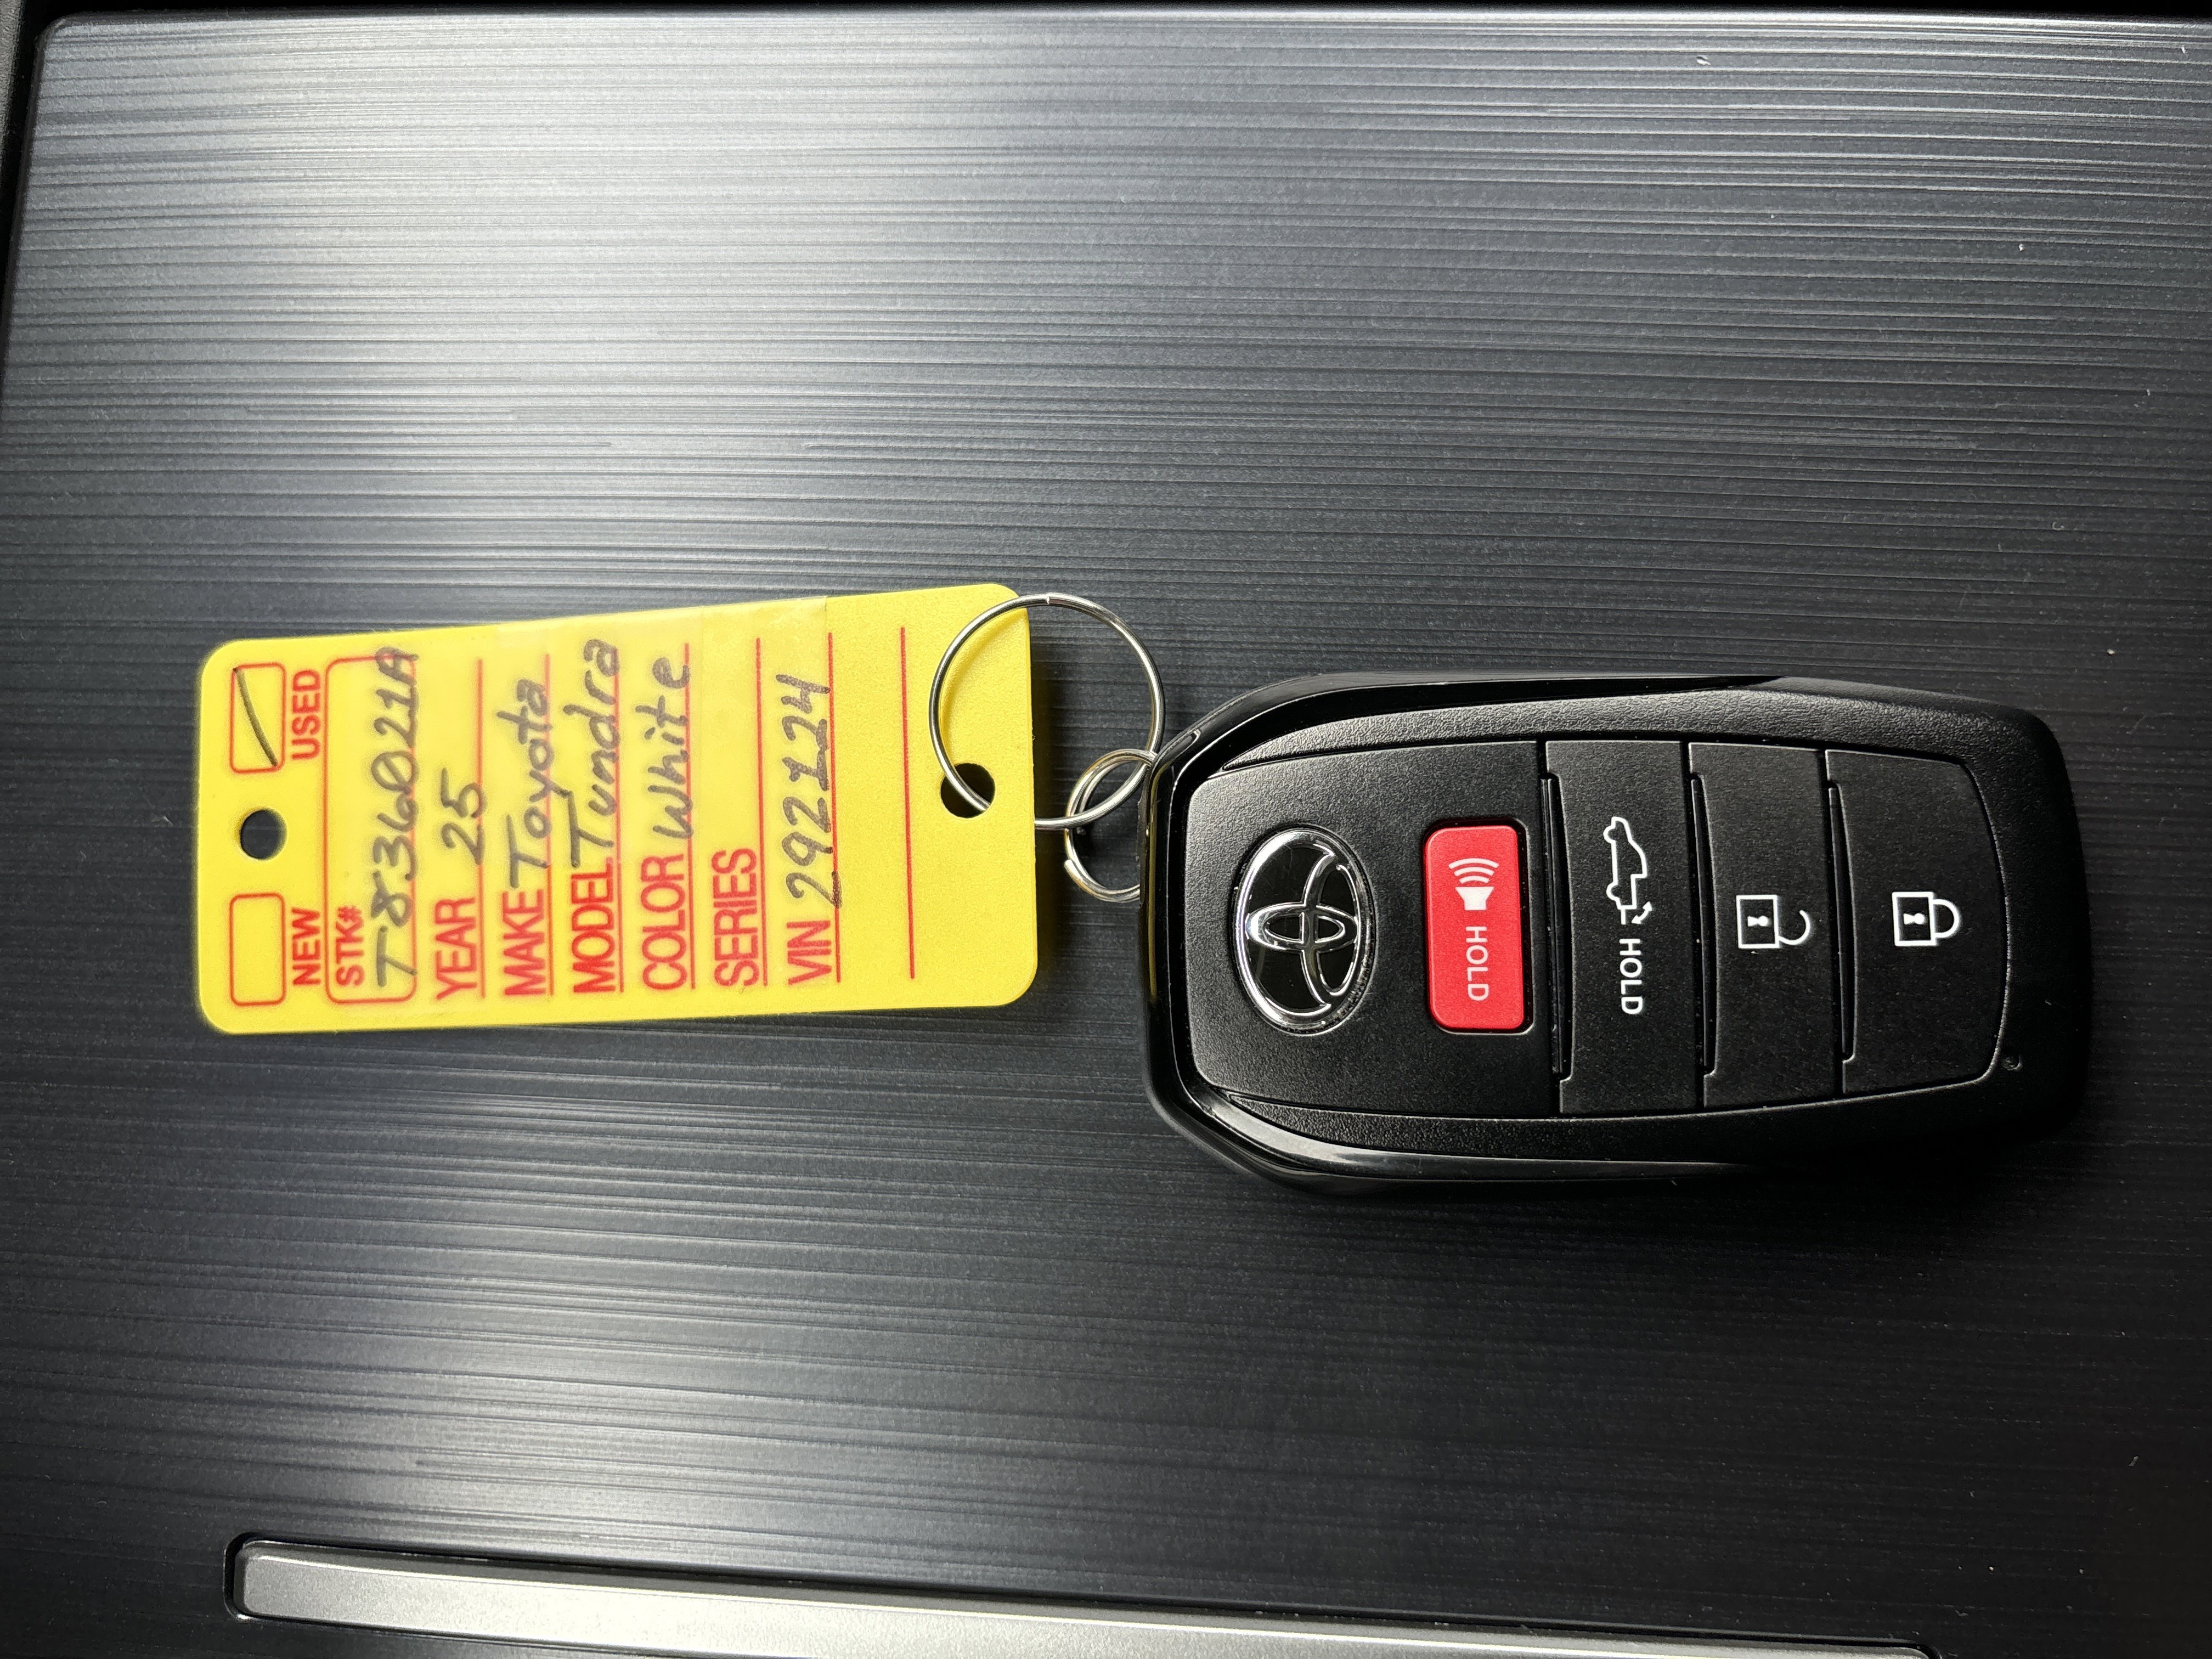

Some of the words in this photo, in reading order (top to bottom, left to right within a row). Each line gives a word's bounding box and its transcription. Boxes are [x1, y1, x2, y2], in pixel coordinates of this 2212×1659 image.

[292, 669, 320, 759] USED
[563, 638, 620, 867] Tundra
[635, 657, 692, 838] White
[441, 768, 484, 864] 25
[497, 679, 569, 887] Toyota
[776, 674, 842, 907] 292124
[292, 907, 320, 985] NEW
[335, 906, 363, 986] STK#
[436, 898, 477, 998] YEAR
[503, 890, 544, 995] MAKE
[571, 857, 616, 992] MODEL
[641, 854, 685, 990] COLOR
[712, 848, 759, 986] SERIES
[787, 920, 832, 984] VIN
[1464, 926, 1488, 1002] HOLD
[1618, 938, 1643, 1015] HOLD
